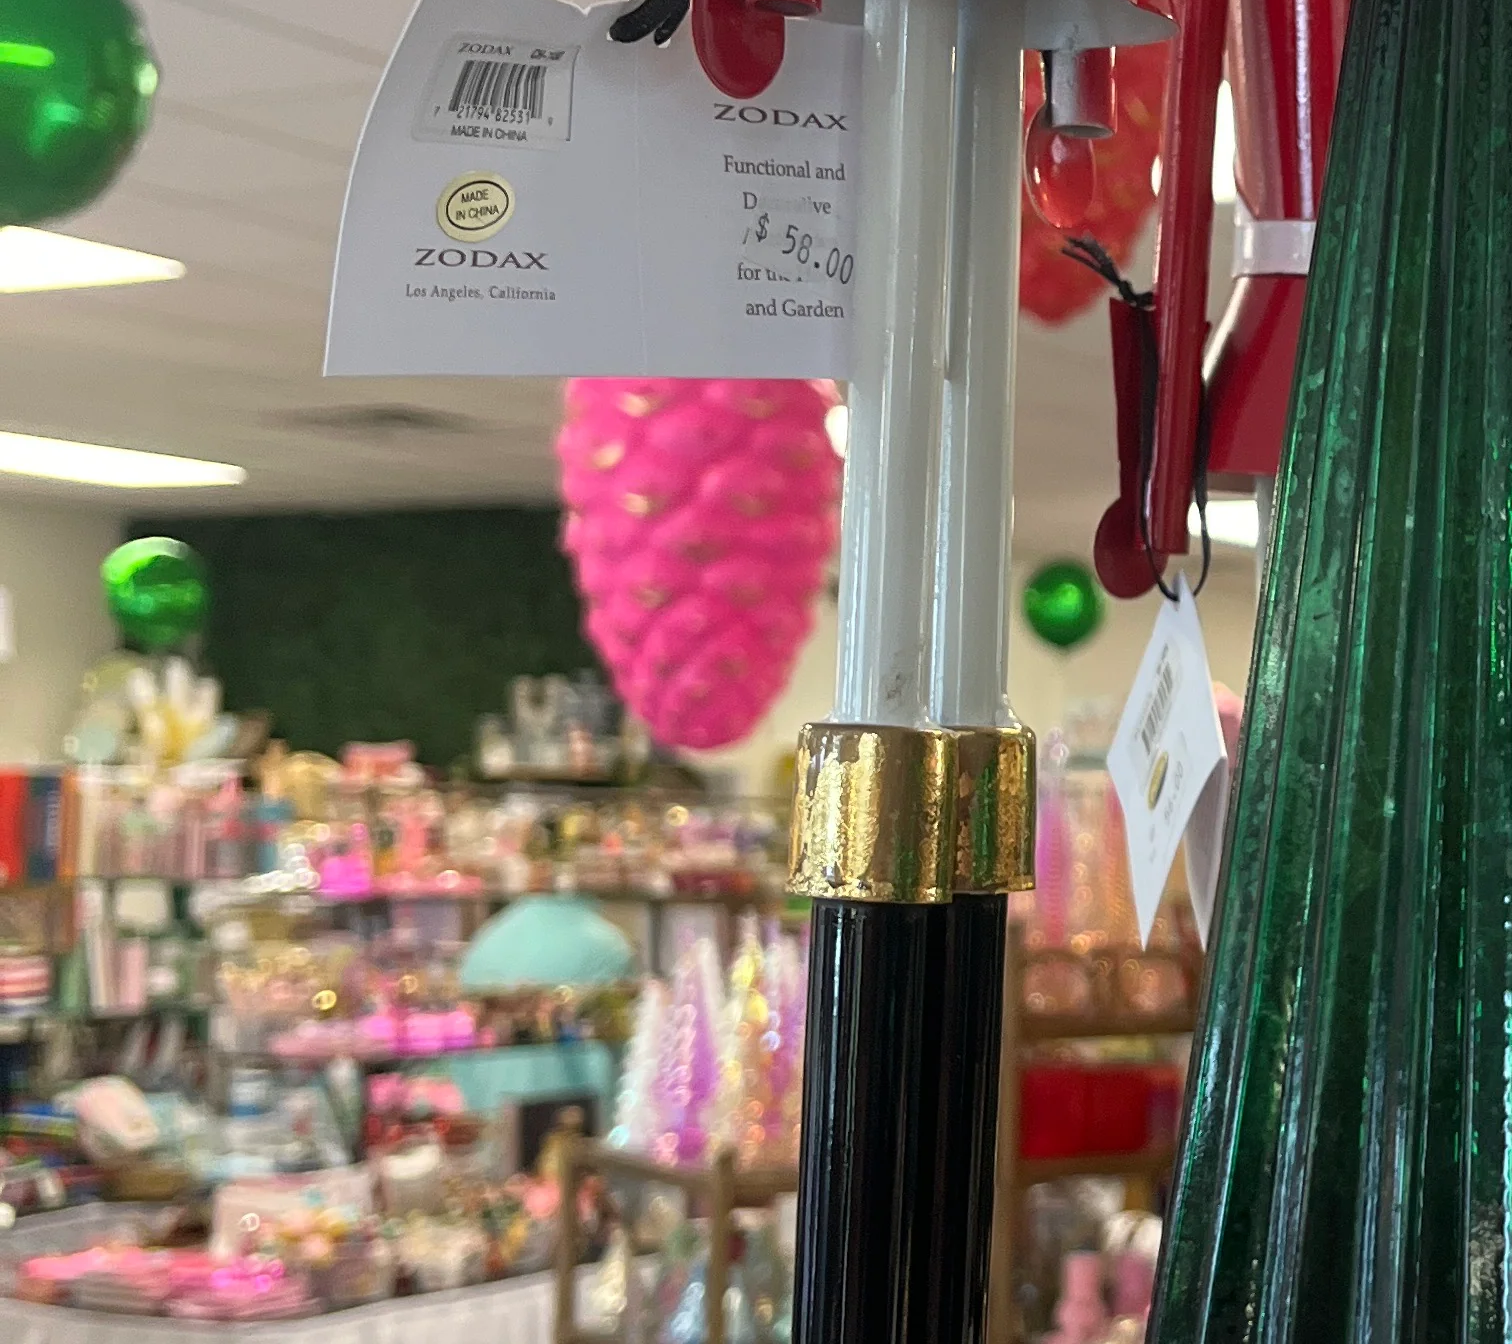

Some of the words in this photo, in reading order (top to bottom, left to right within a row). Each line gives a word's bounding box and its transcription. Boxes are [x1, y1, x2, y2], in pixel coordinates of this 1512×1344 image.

[457, 42, 513, 56] ZODAX
[713, 102, 850, 132] ZODAX
[450, 124, 481, 138] MADE
[481, 126, 493, 139] IN
[494, 128, 528, 142] CHINA
[723, 154, 812, 179] Functional
[815, 162, 847, 182] and
[460, 188, 490, 205] MADE
[455, 210, 467, 221] IN
[468, 204, 500, 219] CHINA
[414, 248, 550, 271] ZODAX
[781, 223, 854, 285] 58.00
[737, 261, 761, 281] for
[405, 283, 427, 298] Los
[430, 285, 484, 302] Angeles,
[489, 286, 556, 301] California
[745, 299, 778, 317] and
[782, 298, 845, 319] Garden
